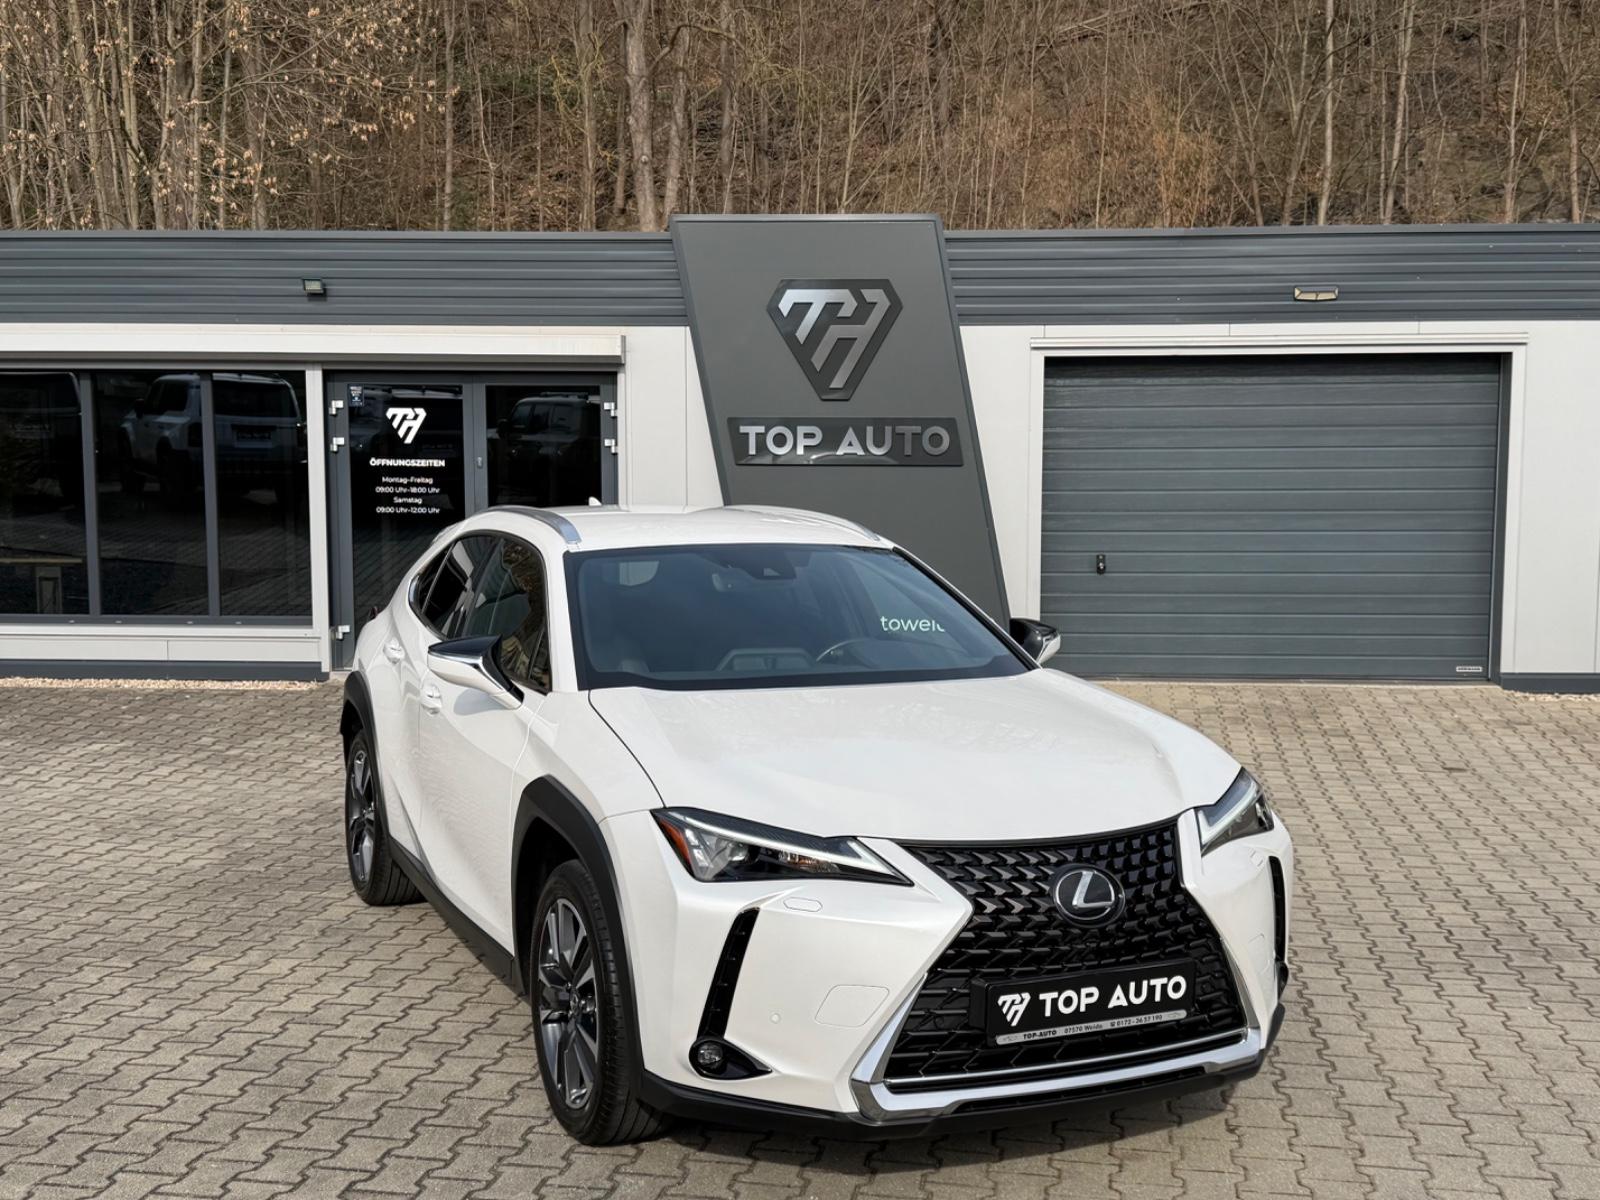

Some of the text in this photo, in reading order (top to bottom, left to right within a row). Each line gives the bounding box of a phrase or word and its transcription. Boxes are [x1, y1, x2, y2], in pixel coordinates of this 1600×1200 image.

[739, 425, 951, 456] TOP AUTO
[369, 456, 446, 467] ÖFFNUNGSZEITEN
[381, 476, 434, 485] Montag-Freitag
[392, 496, 423, 505] Samstag
[375, 506, 395, 514] 09:00
[427, 506, 441, 514] Uhr
[1038, 986, 1100, 1017] TOP
[1107, 975, 1187, 1009] AUTO
[1023, 1029, 1058, 1040] TOP-AUTO
